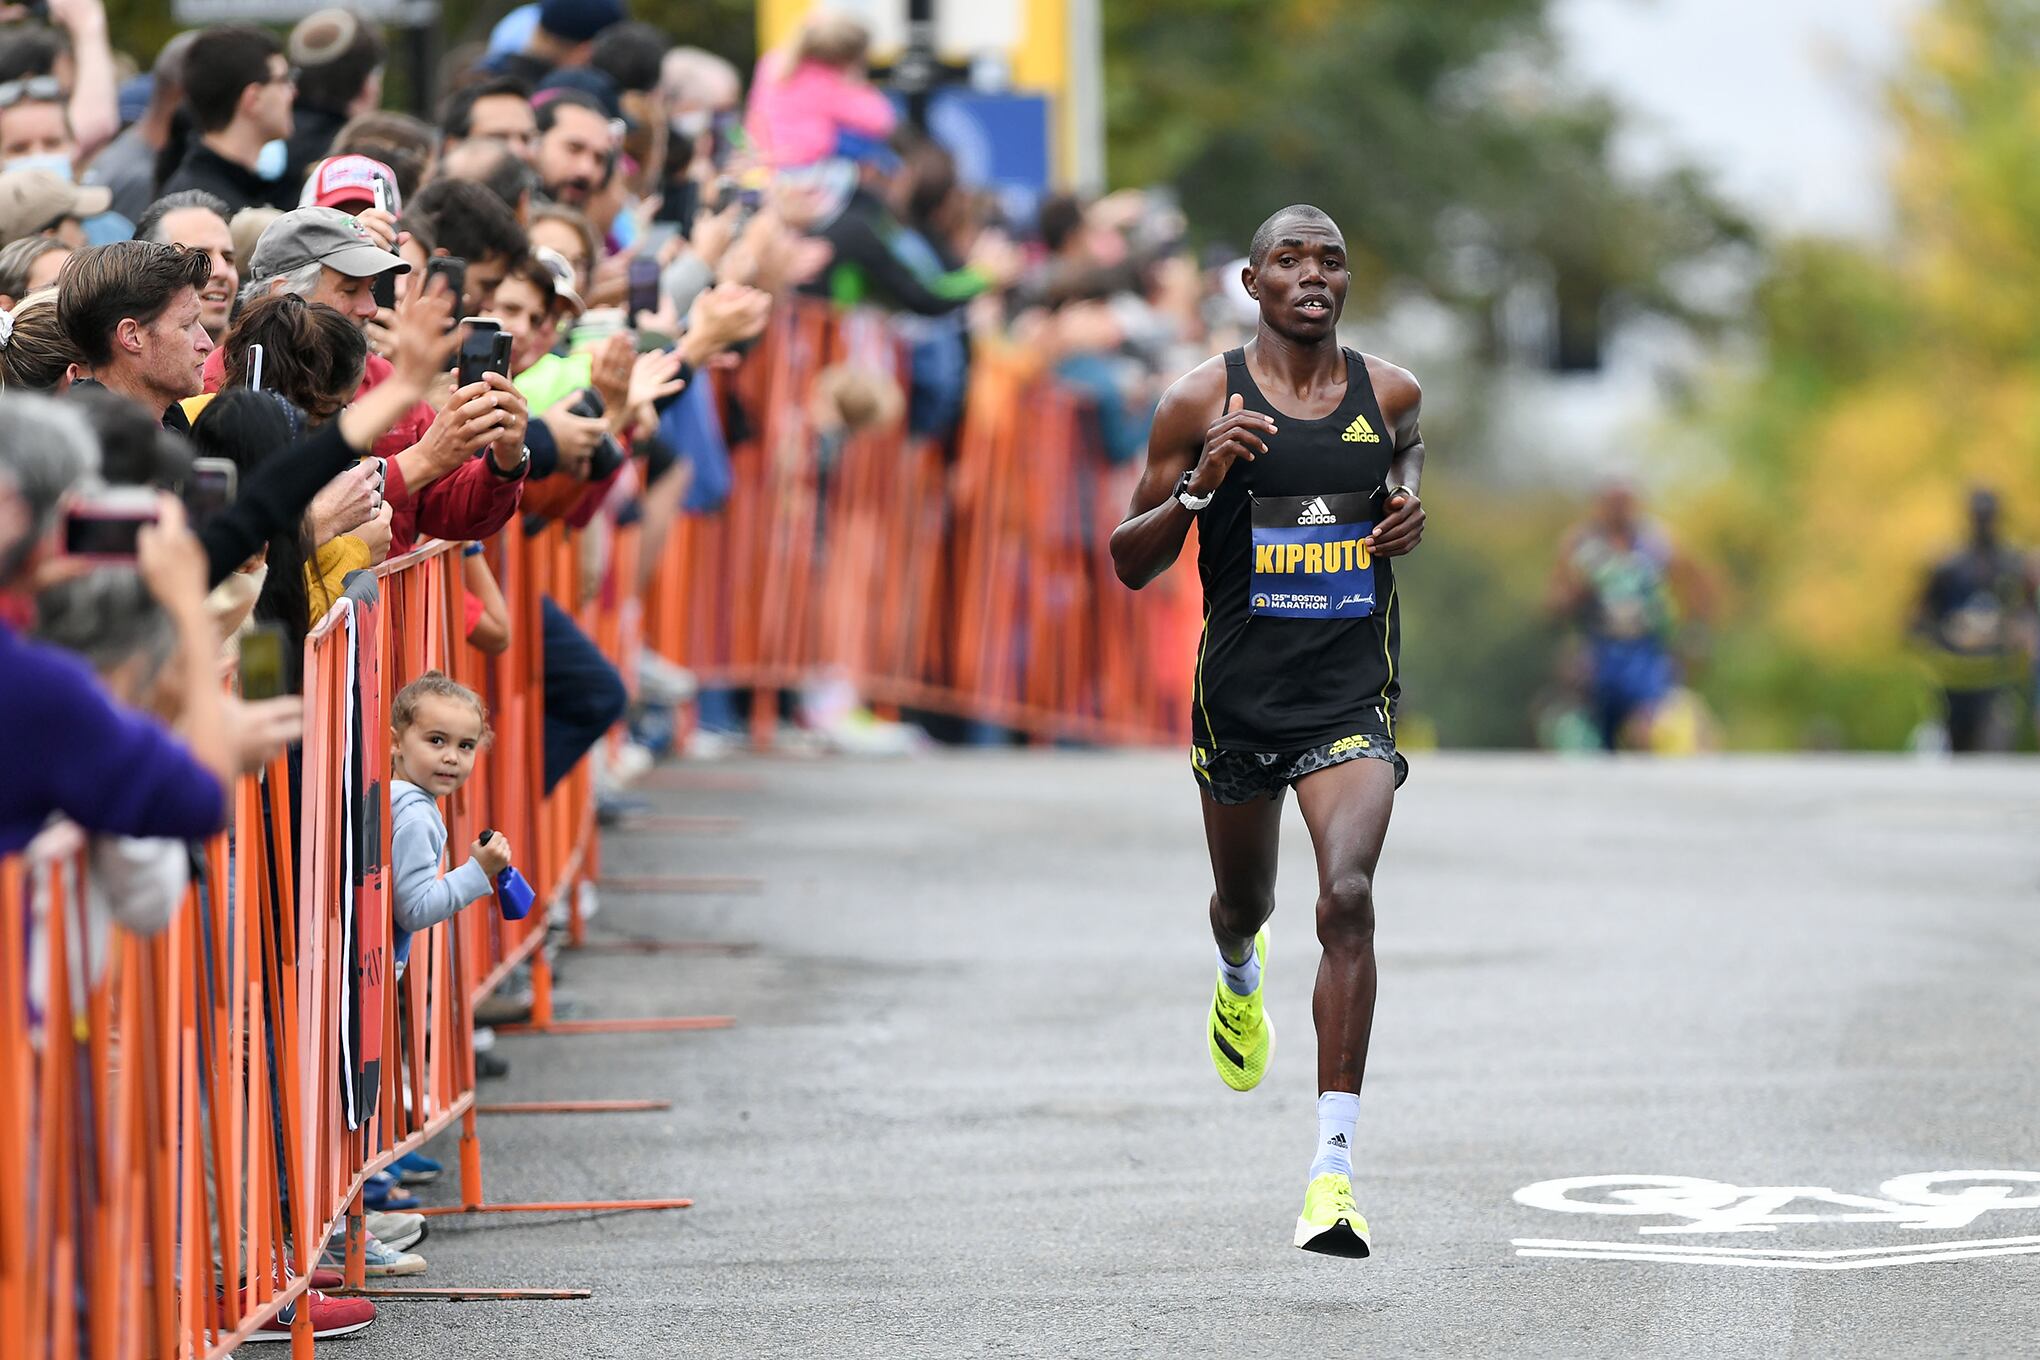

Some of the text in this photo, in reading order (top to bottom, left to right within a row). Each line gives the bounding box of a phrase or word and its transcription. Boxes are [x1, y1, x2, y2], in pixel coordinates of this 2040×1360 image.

[1341, 432, 1380, 444] adidas
[1297, 514, 1337, 525] adidas
[1255, 538, 1371, 574] KIPRUTO
[1291, 594, 1327, 603] BOSTON
[1271, 601, 1328, 610] MARATHON
[1329, 740, 1370, 755] adidas
[1327, 1140, 1349, 1149] adidas
